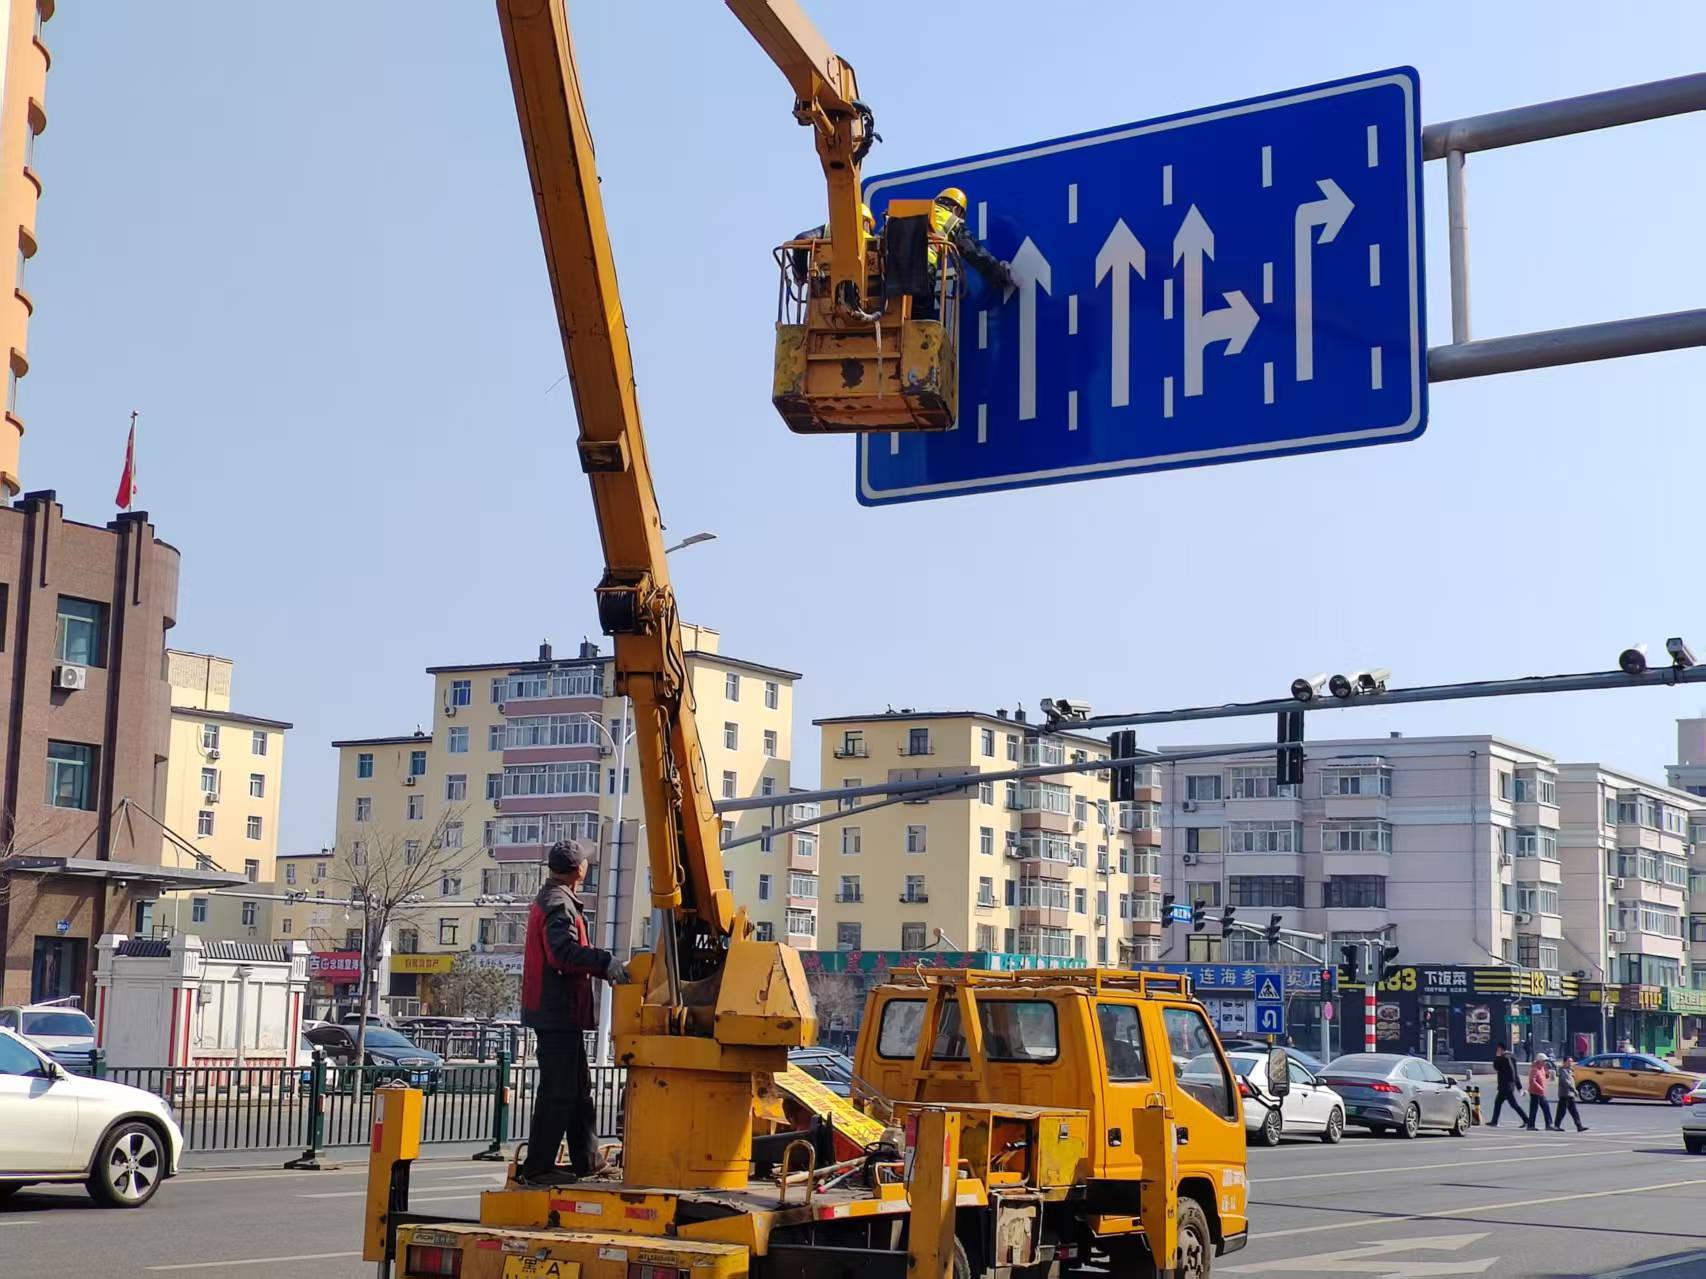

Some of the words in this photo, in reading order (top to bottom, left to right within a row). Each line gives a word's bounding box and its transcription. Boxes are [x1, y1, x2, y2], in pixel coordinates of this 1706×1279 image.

[1179, 967, 1321, 986] 连海参卖店
[1424, 970, 1467, 985] 下饭菜
[1531, 971, 1546, 996] 133
